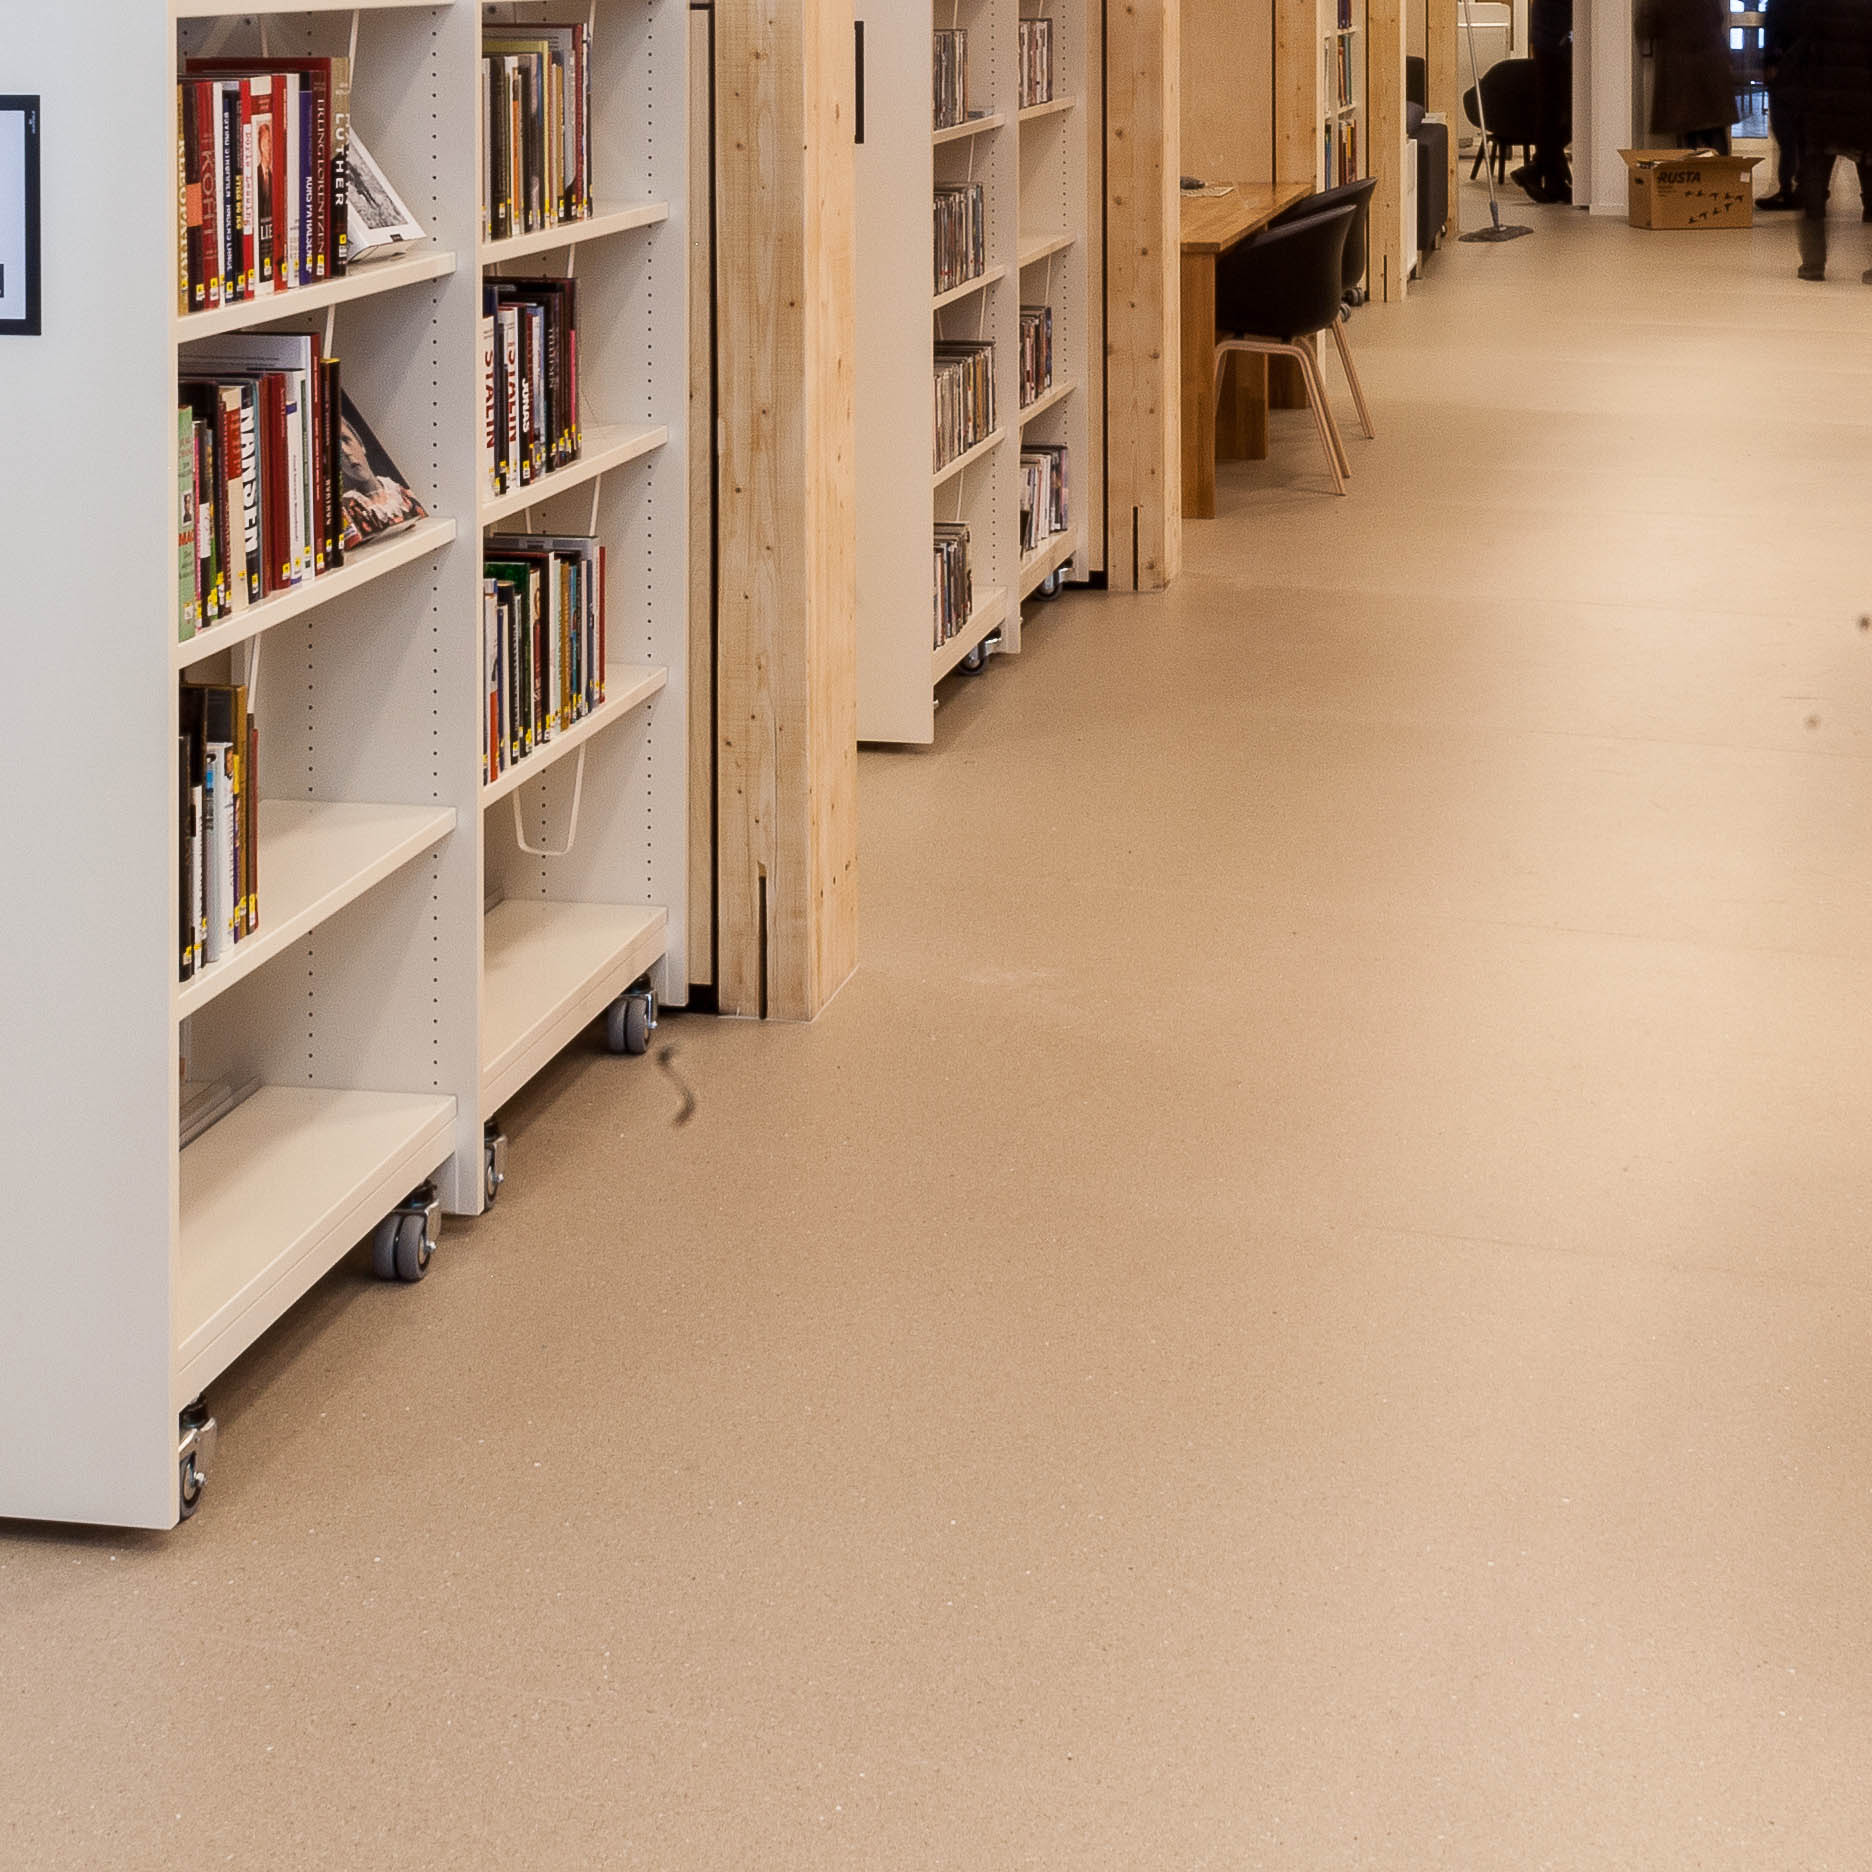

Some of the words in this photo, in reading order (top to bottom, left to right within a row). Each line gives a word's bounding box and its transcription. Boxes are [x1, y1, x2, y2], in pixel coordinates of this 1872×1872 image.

[201, 150, 215, 236] KOHT
[335, 113, 345, 206] LUTHER
[1657, 171, 1701, 184] RUSTA
[484, 350, 495, 449] STALIN
[522, 378, 530, 433] JONAS
[240, 406, 258, 553] NANSEN
